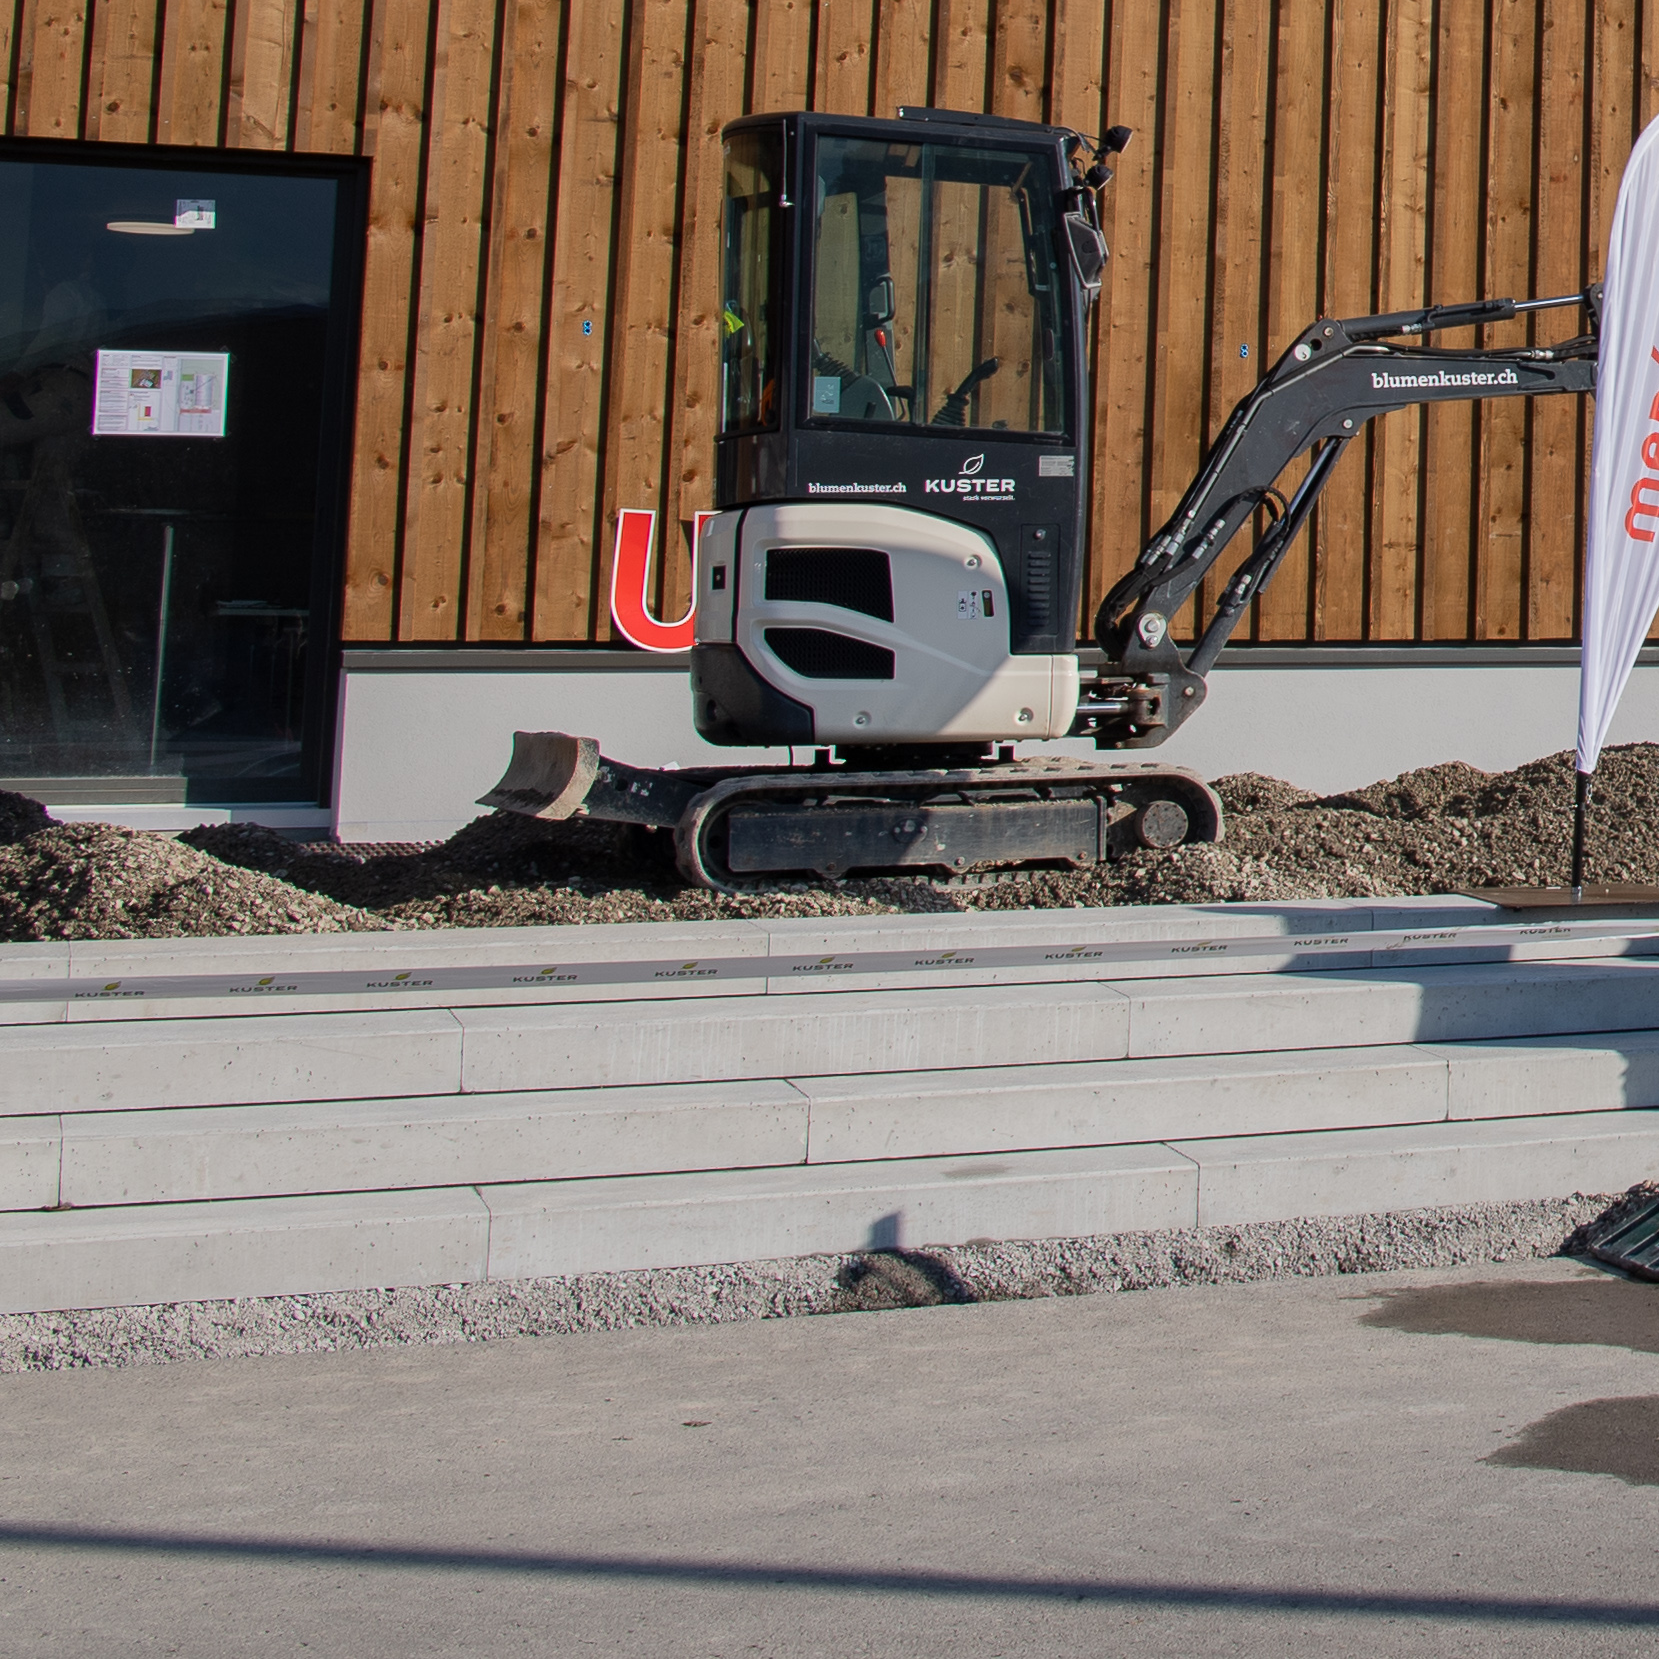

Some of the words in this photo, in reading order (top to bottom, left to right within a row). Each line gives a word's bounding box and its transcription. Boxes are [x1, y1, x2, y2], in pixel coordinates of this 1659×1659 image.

[1371, 369, 1518, 389] blumenkuster.ch
[808, 482, 907, 494] blumenkuster.ch
[925, 479, 1016, 493] KUSTER
[1404, 932, 1457, 942] KUSTER
[1294, 938, 1349, 946] KUSTER
[1171, 945, 1228, 953] KUSTER
[1045, 951, 1103, 959] KUSTER
[915, 958, 975, 966] KUSTER
[793, 963, 854, 972] KUSTER
[655, 969, 718, 977] KUSTER
[513, 974, 578, 982] KUSTER
[367, 980, 433, 988] KUSTER
[229, 985, 298, 993] KUSTER
